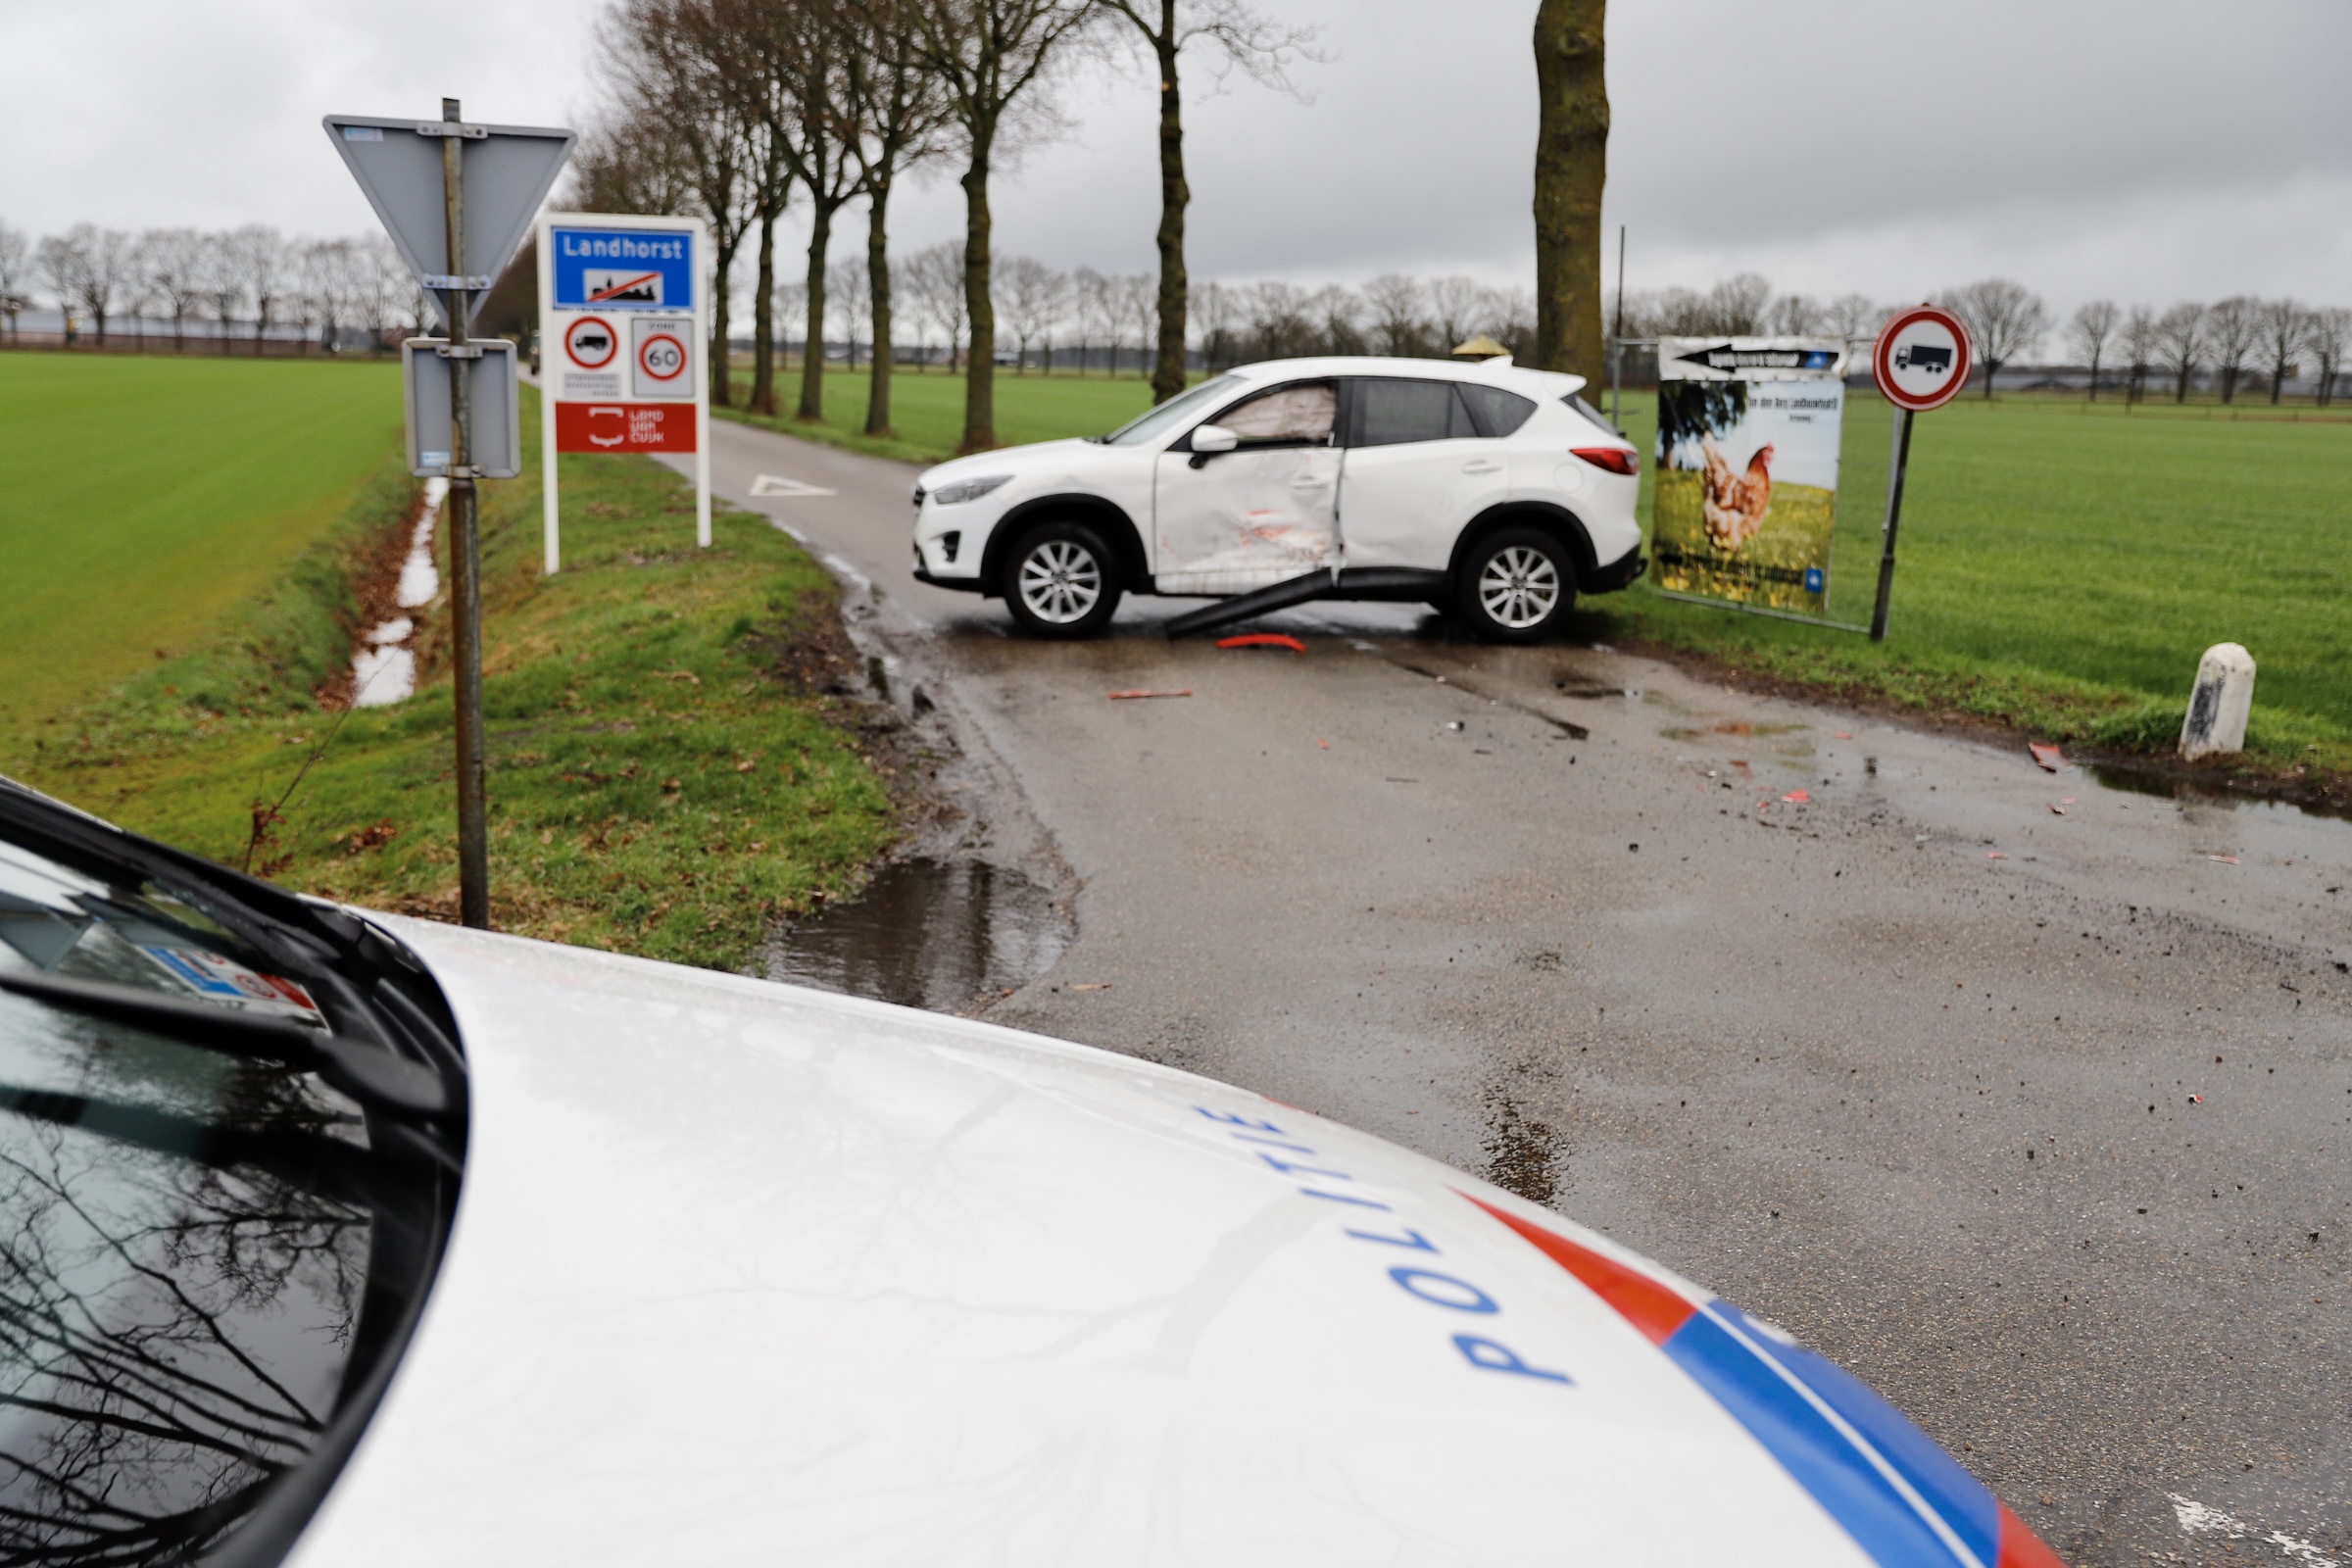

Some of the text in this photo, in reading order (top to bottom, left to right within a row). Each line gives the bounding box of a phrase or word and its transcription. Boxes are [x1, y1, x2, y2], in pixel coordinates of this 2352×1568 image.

[564, 235, 683, 260] Landhorst
[649, 349, 678, 368] 60
[1193, 1105, 1577, 1388] POLITIE
